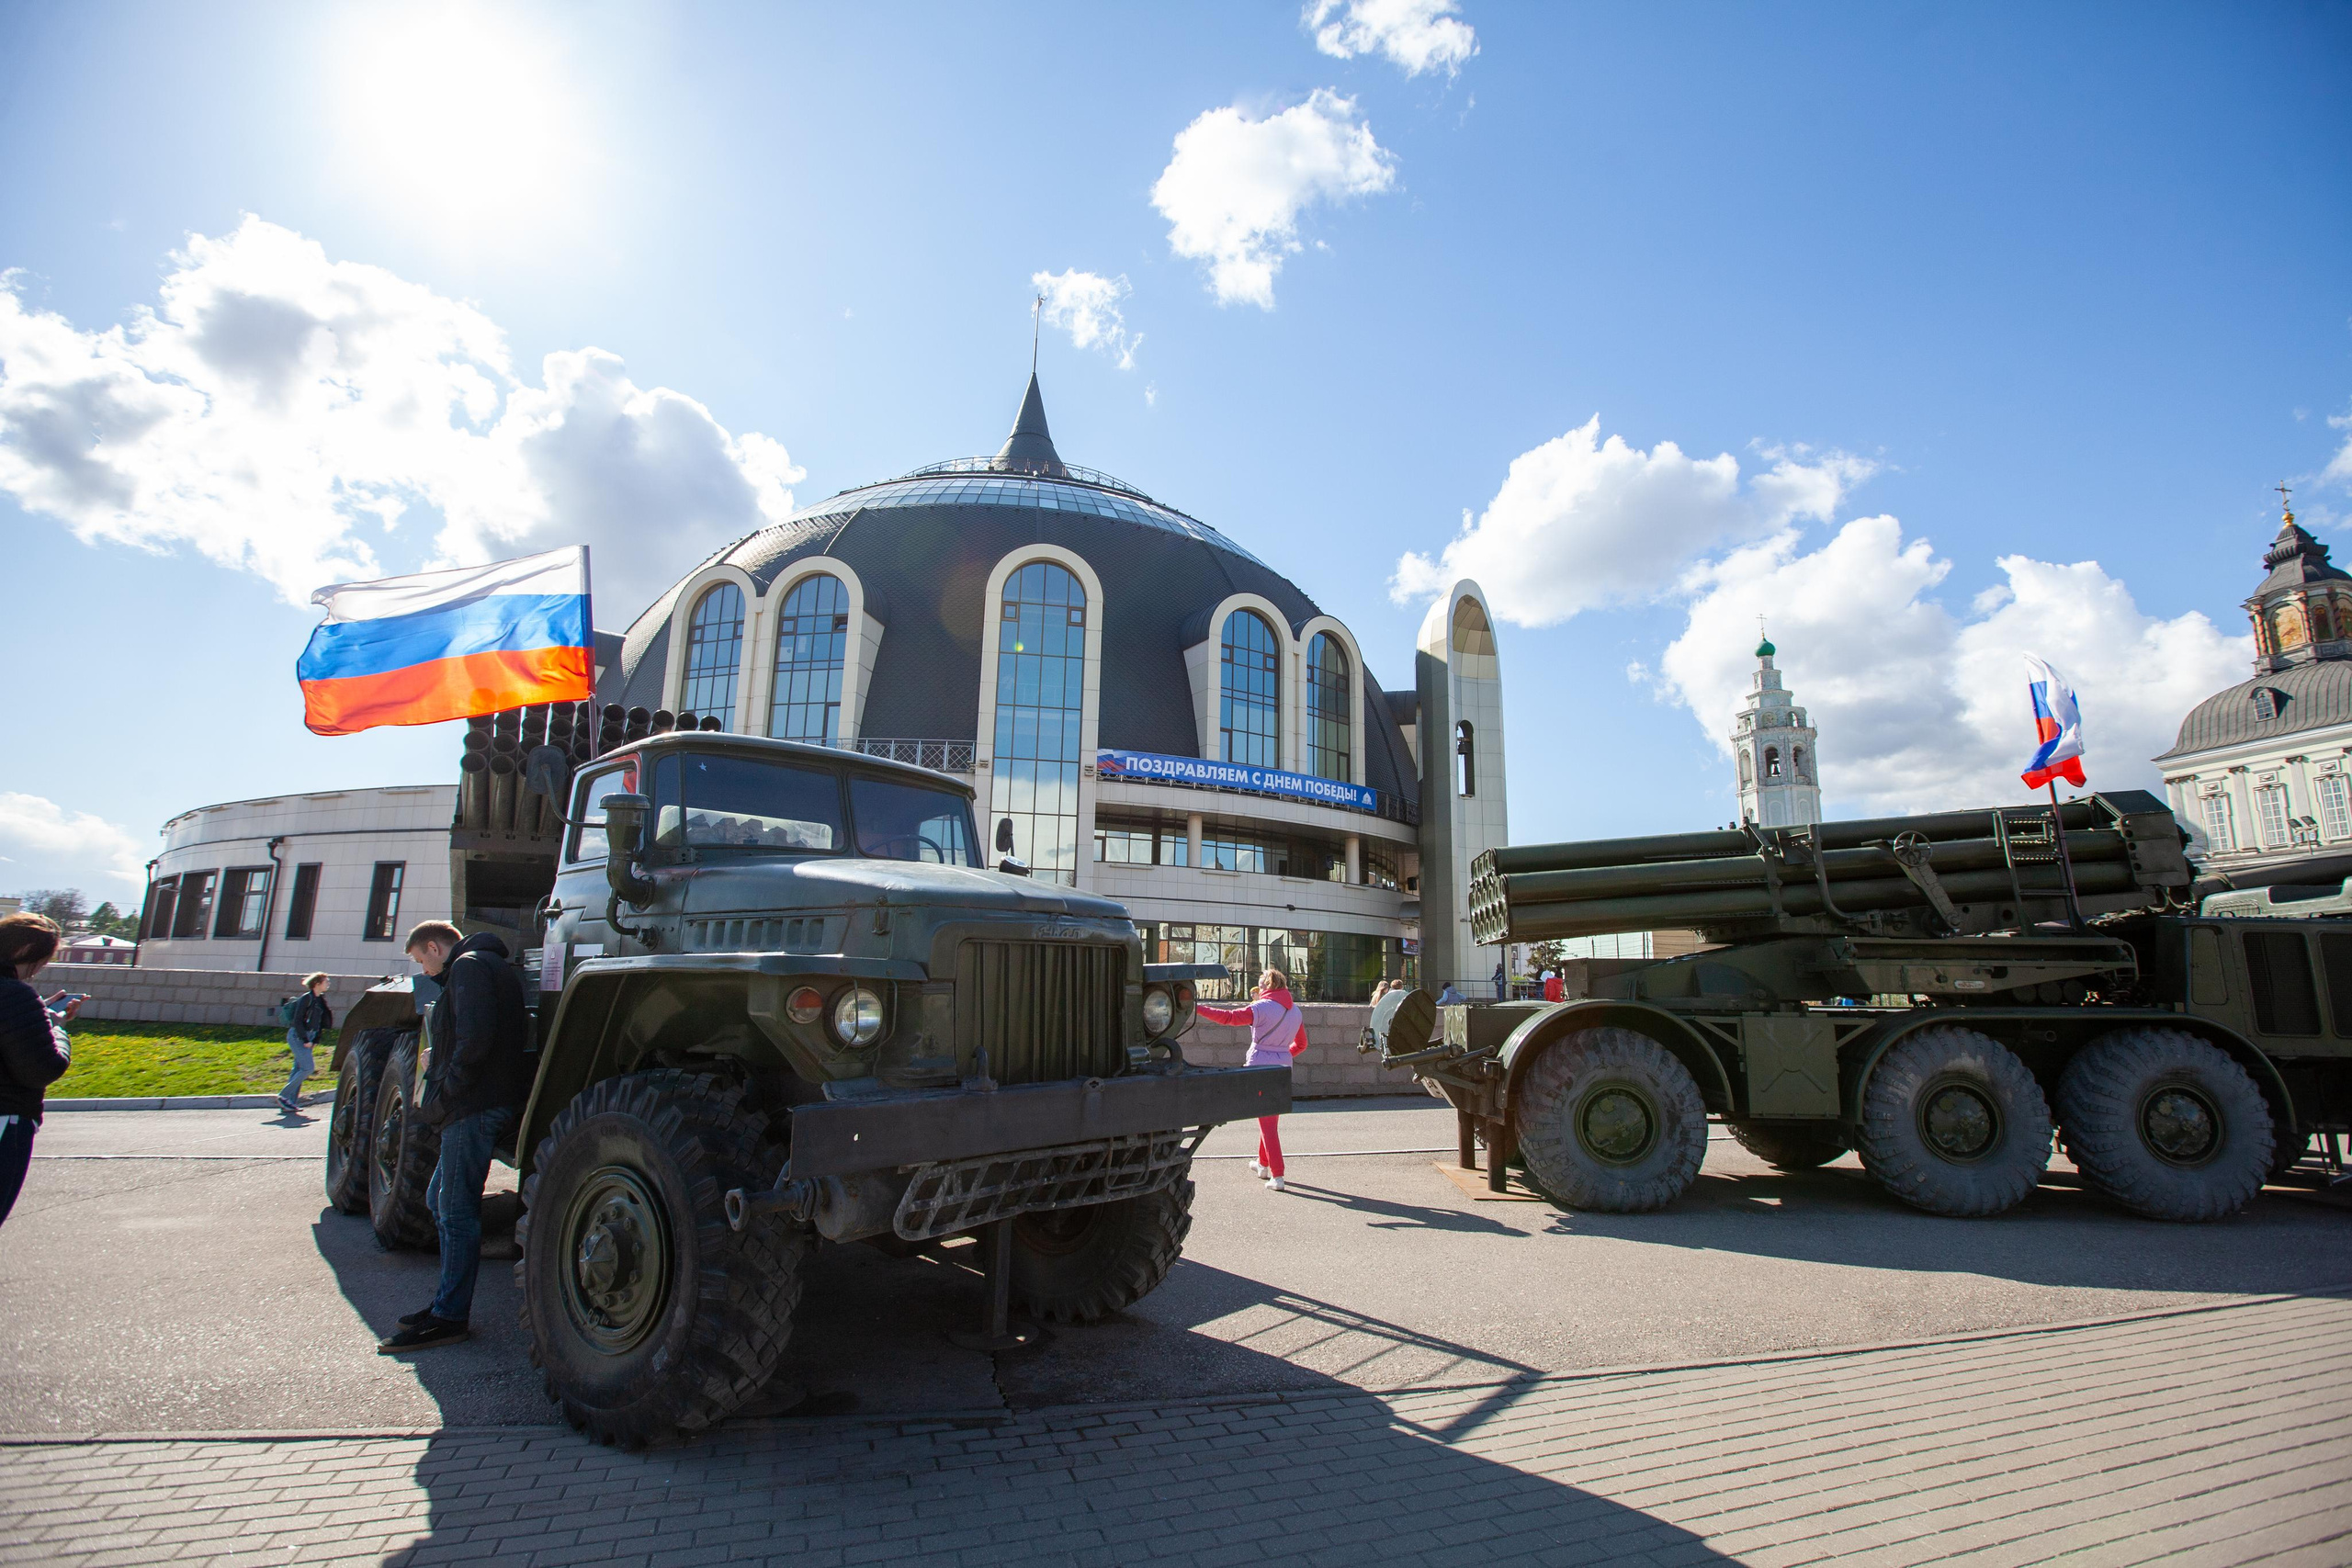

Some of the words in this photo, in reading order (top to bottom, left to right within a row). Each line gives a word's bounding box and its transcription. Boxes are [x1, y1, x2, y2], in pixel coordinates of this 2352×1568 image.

[1125, 756, 1249, 784] ПОЗДРАВЛЯЕМ
[1251, 772, 1261, 785] С
[1263, 773, 1303, 792] ДНЕМ
[1306, 780, 1357, 802] ПОБЕДЫ!
